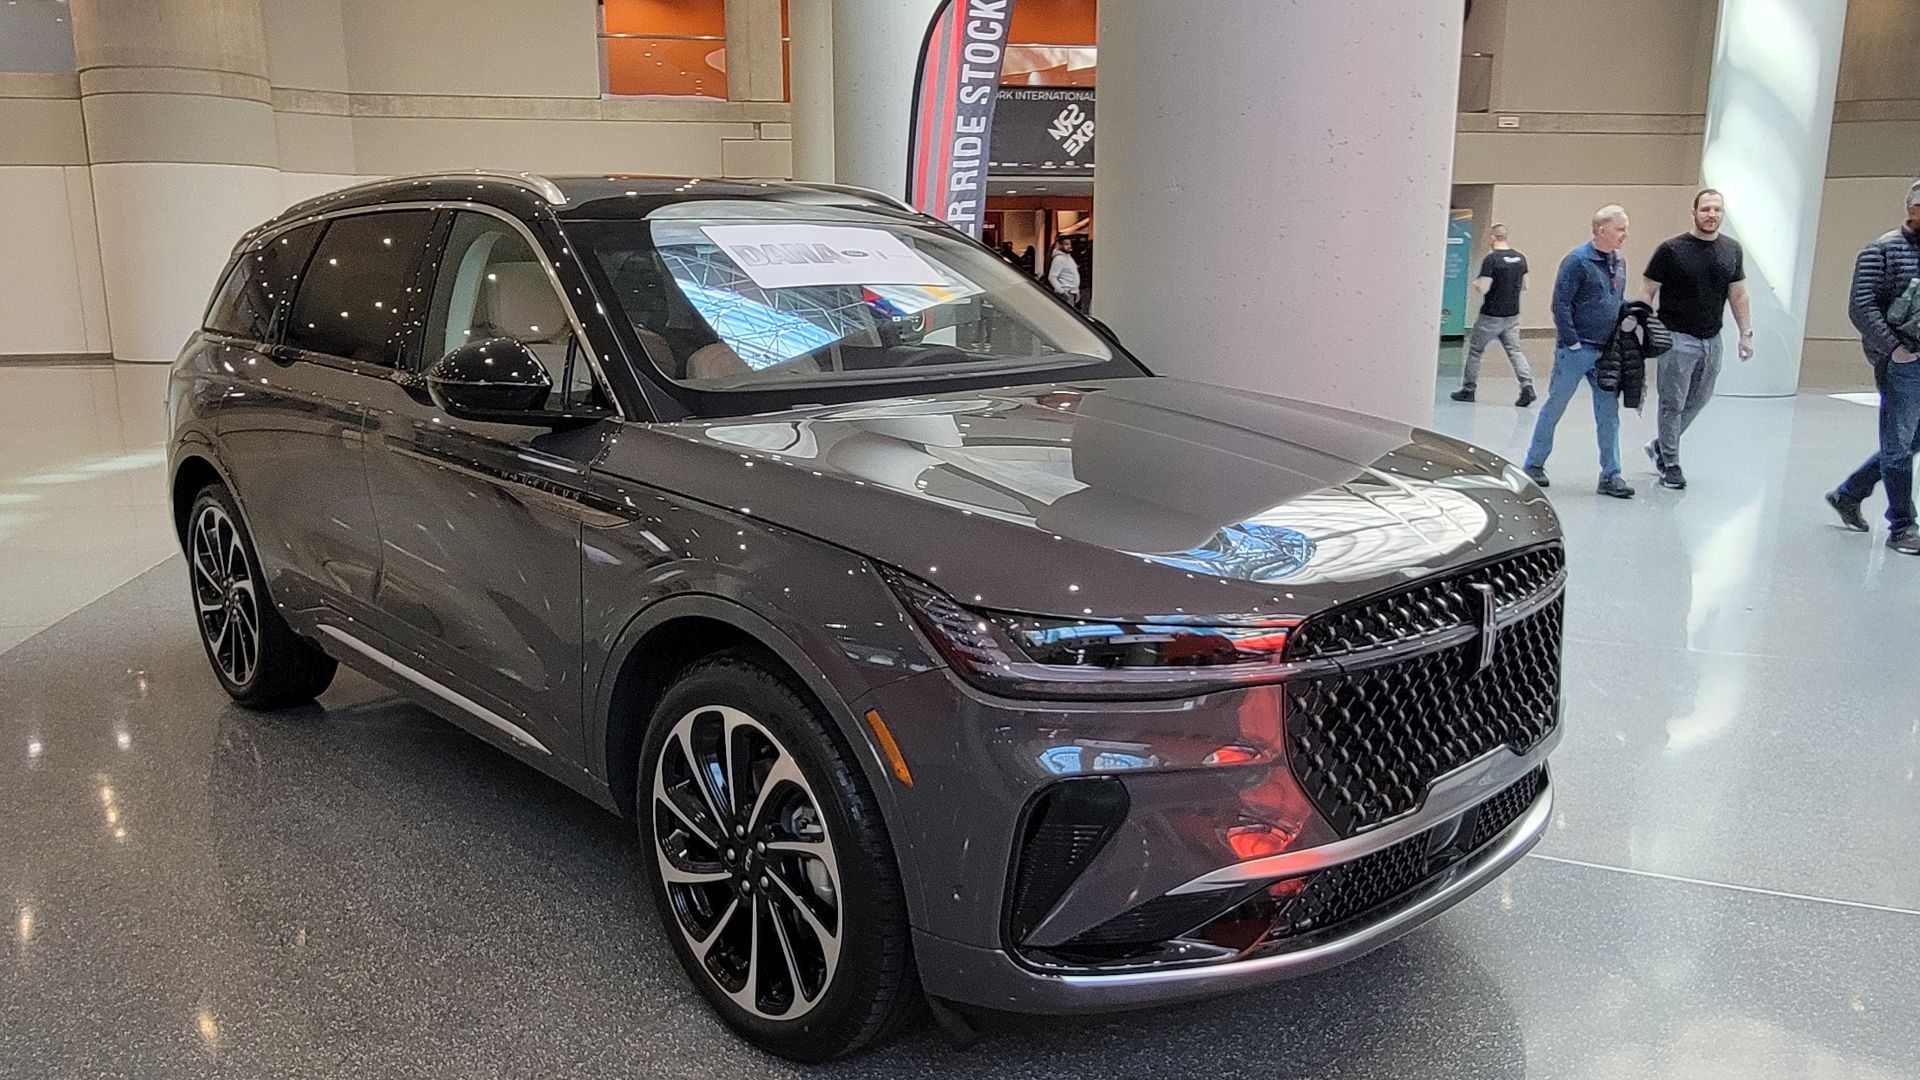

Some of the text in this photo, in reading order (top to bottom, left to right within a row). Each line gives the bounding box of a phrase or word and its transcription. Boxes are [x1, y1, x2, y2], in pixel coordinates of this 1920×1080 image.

[960, 0, 1008, 104] STOCK
[996, 91, 1096, 101] RK INTERNATIONAL
[949, 116, 987, 191] RIDE
